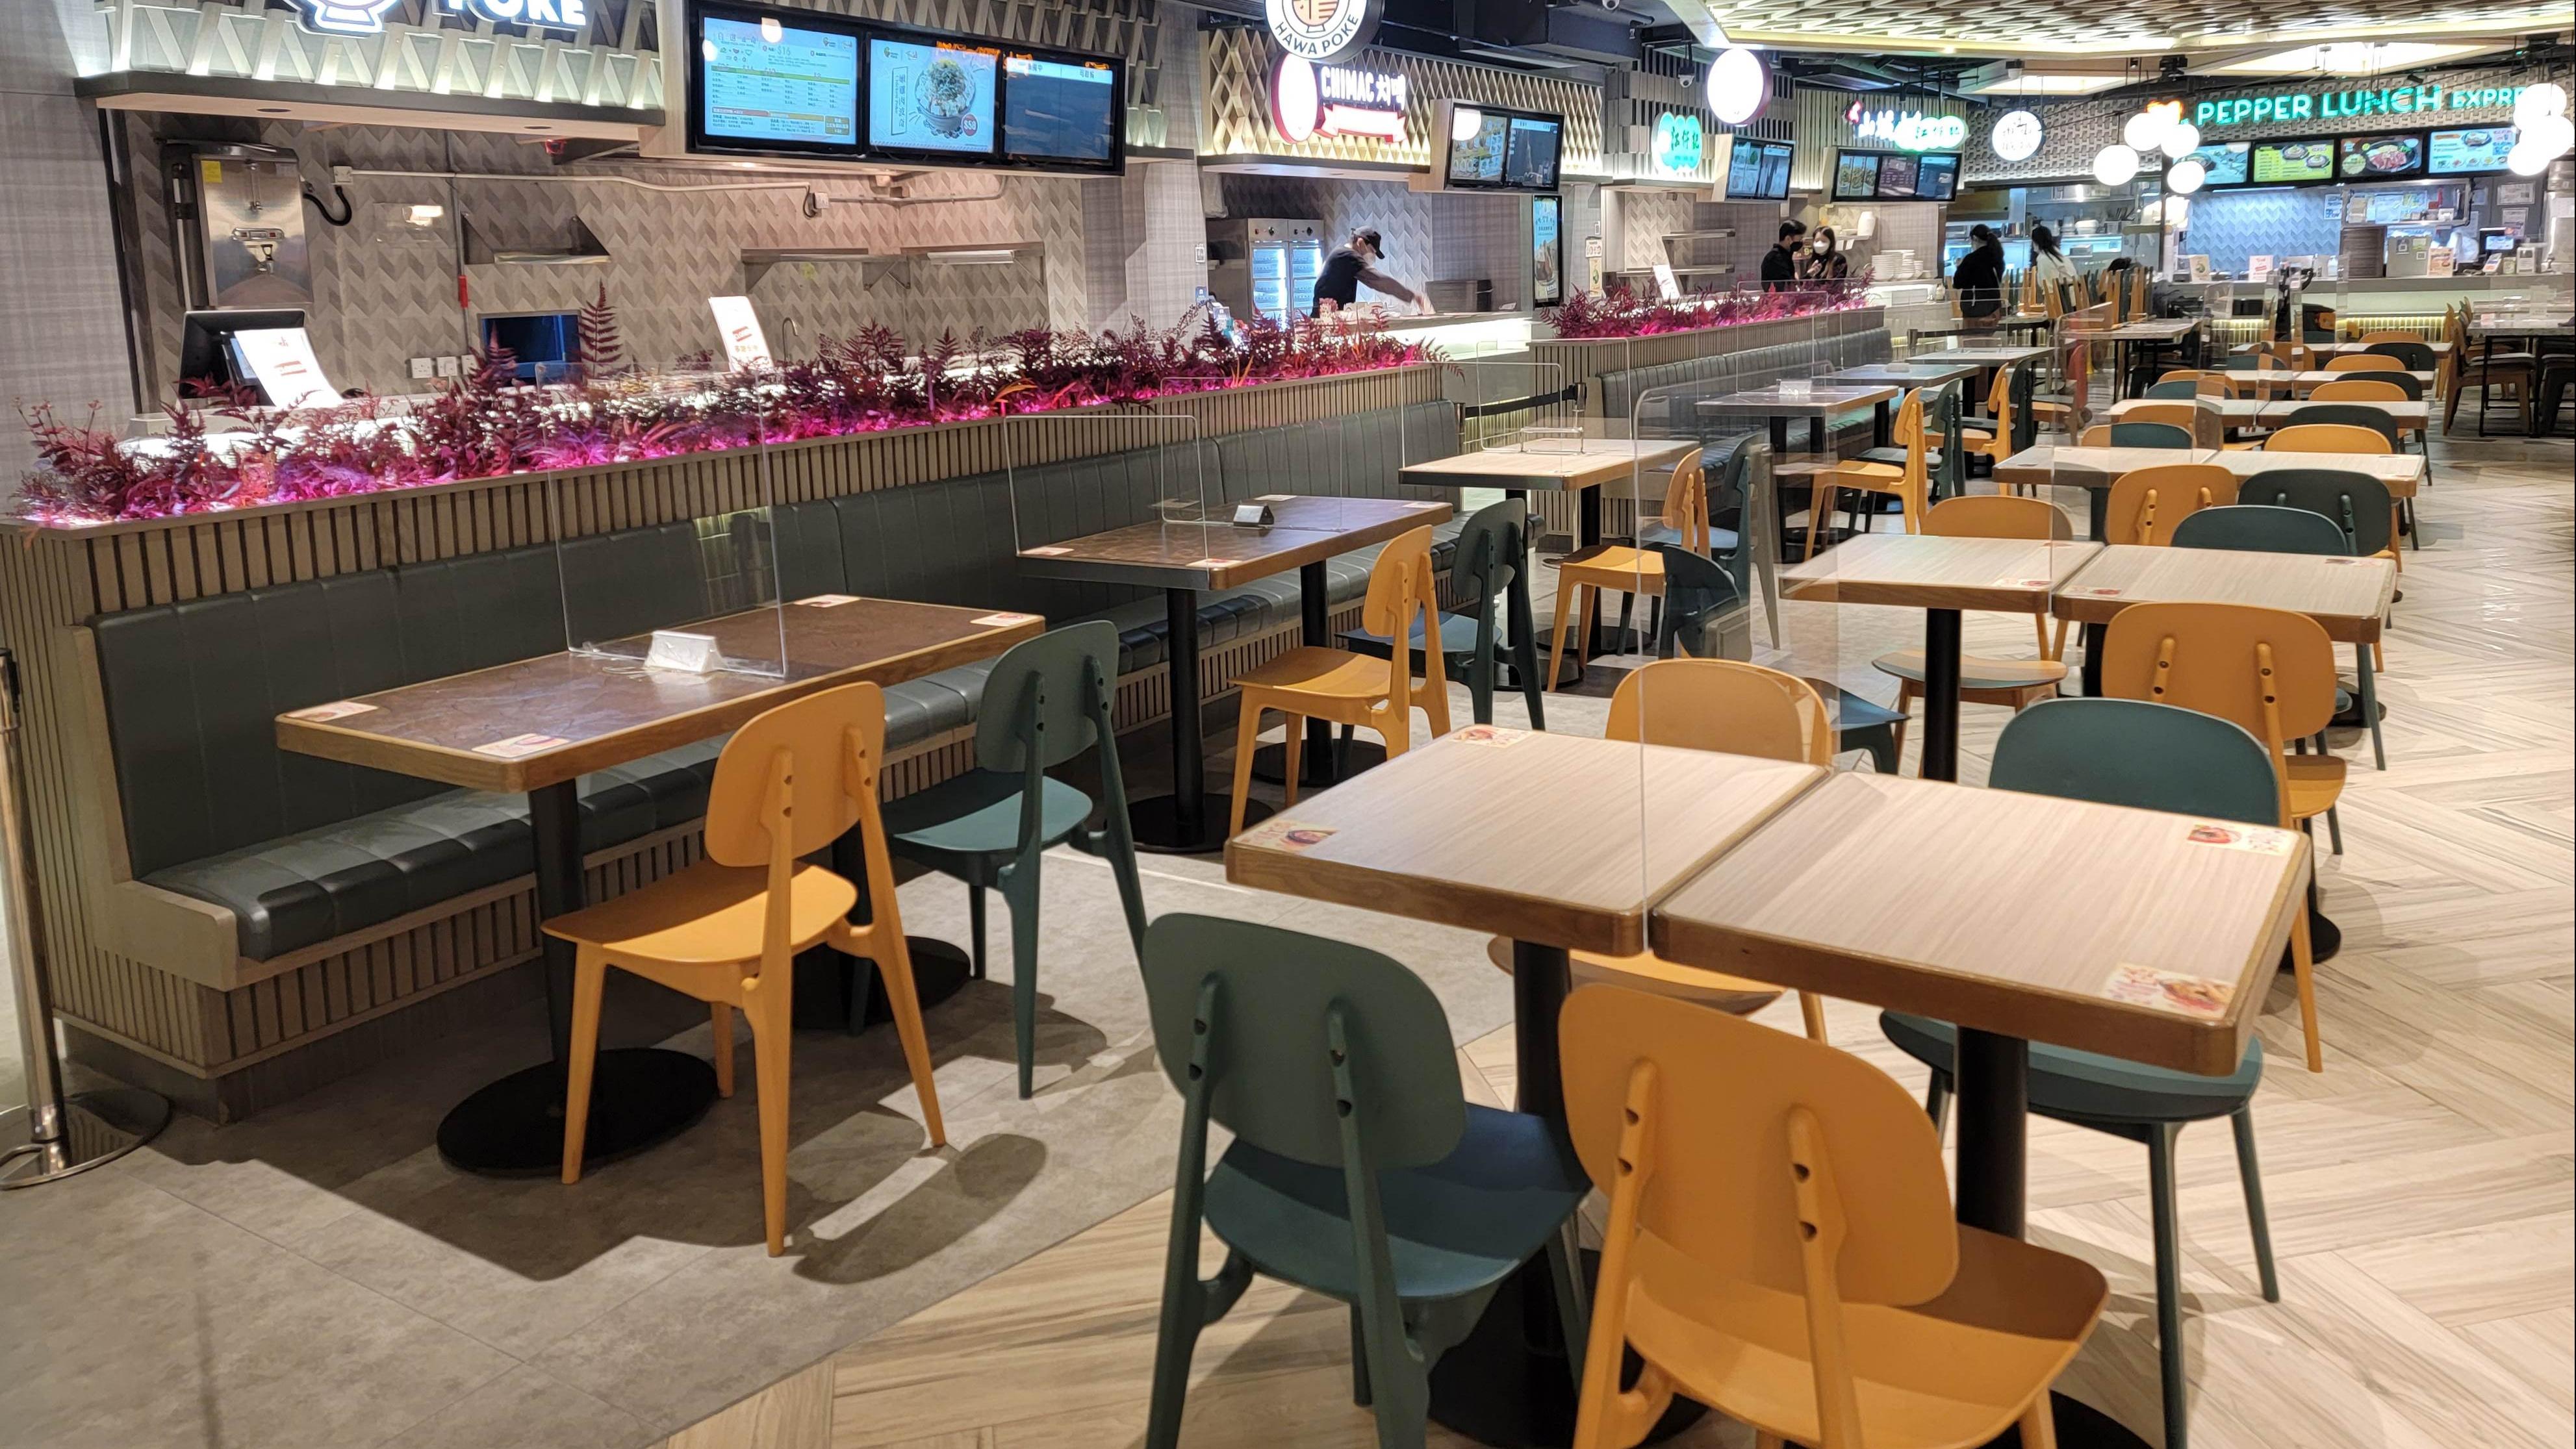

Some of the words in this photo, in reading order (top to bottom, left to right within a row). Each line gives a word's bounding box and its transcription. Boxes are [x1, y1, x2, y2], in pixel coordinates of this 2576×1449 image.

[1275, 21, 1318, 55] HAWA
[1321, 14, 1359, 53] POKE
[1321, 66, 1375, 103] CHIMAC
[2196, 94, 2312, 126] PEPPER
[2321, 84, 2441, 118] LUNCH
